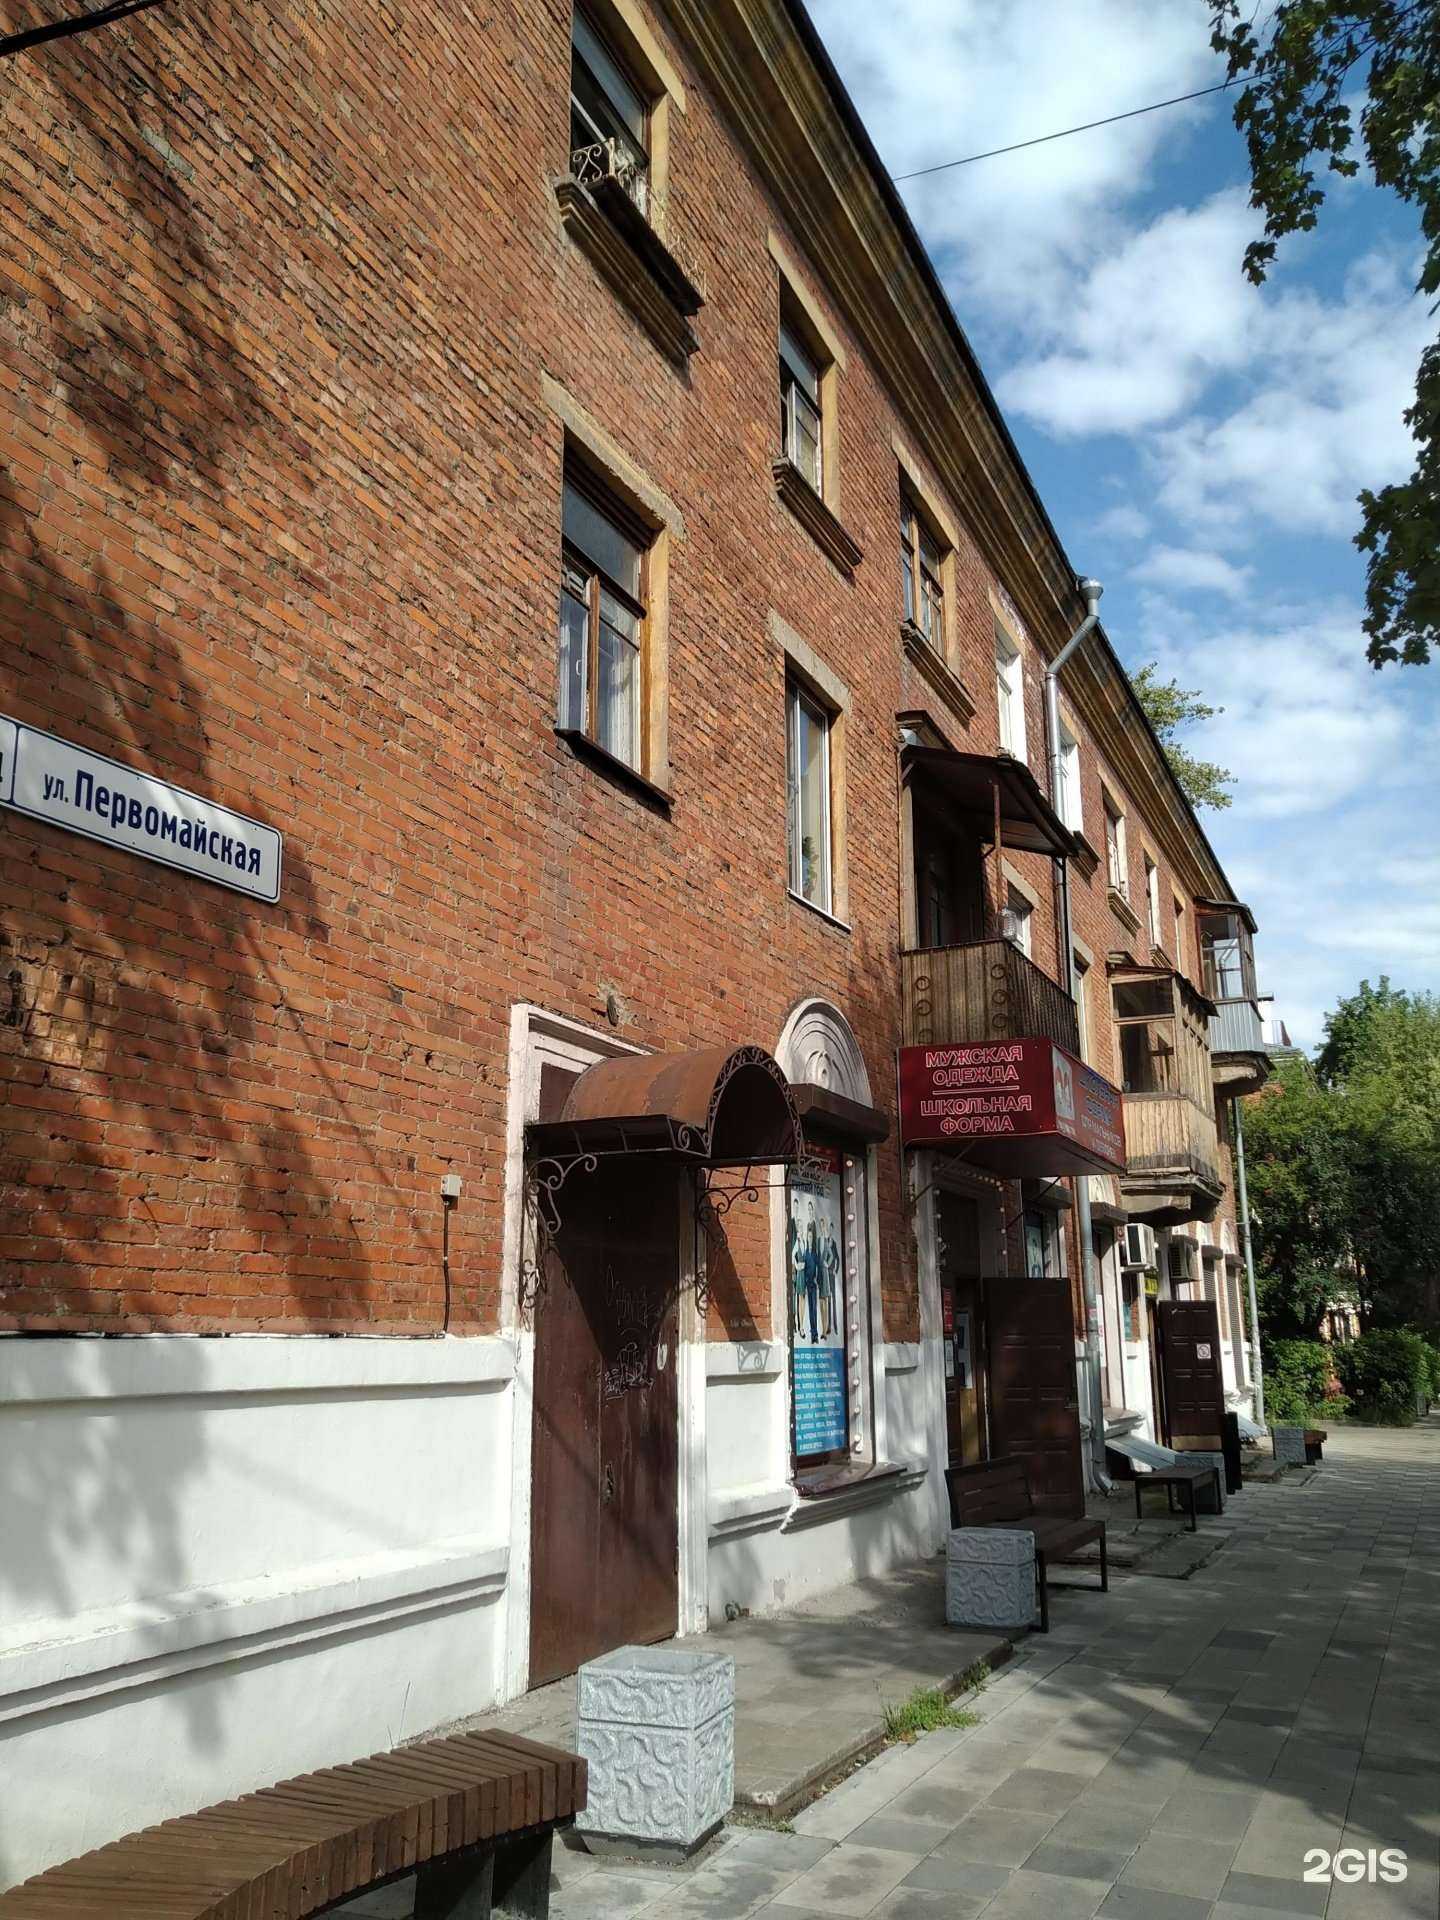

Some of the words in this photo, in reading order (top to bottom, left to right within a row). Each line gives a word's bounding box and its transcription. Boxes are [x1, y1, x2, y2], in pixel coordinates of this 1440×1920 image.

[43, 774, 69, 803] ул.
[74, 769, 261, 876] Первомайская
[925, 1045, 1023, 1067] МУЖСКАЯ
[932, 1065, 1019, 1087] ОДЕЖДА
[920, 1095, 1032, 1117] ШКОЛЬНАЯ
[940, 1115, 1015, 1135] ФОРМА
